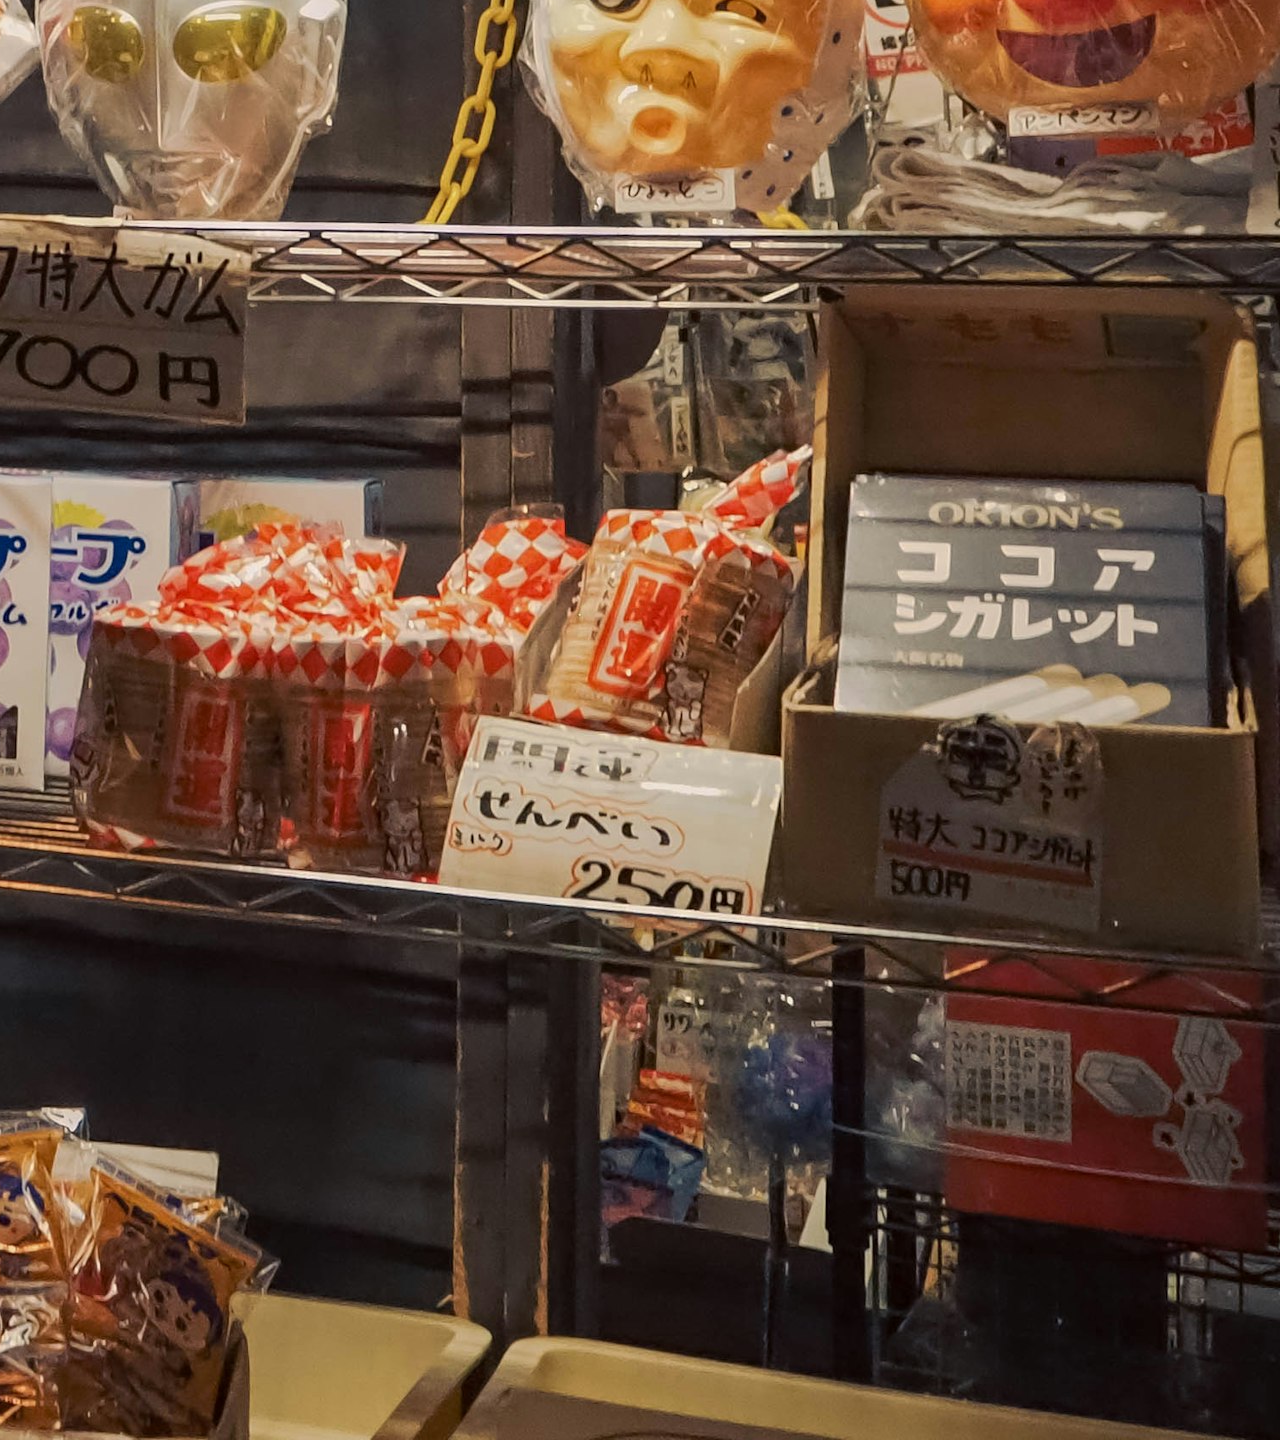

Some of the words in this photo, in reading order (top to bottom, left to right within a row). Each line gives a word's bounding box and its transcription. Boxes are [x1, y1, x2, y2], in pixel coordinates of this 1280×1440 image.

[1018, 108, 1141, 130] アンパンマン
[622, 176, 718, 200] ひょっとこ
[928, 500, 1125, 531] ORION'S
[896, 540, 1157, 592] ココア
[892, 592, 1160, 648] シガレット
[476, 789, 672, 847] せんべい
[889, 807, 958, 849] 特大
[570, 859, 746, 913] 250円
[890, 859, 972, 902] 500円
